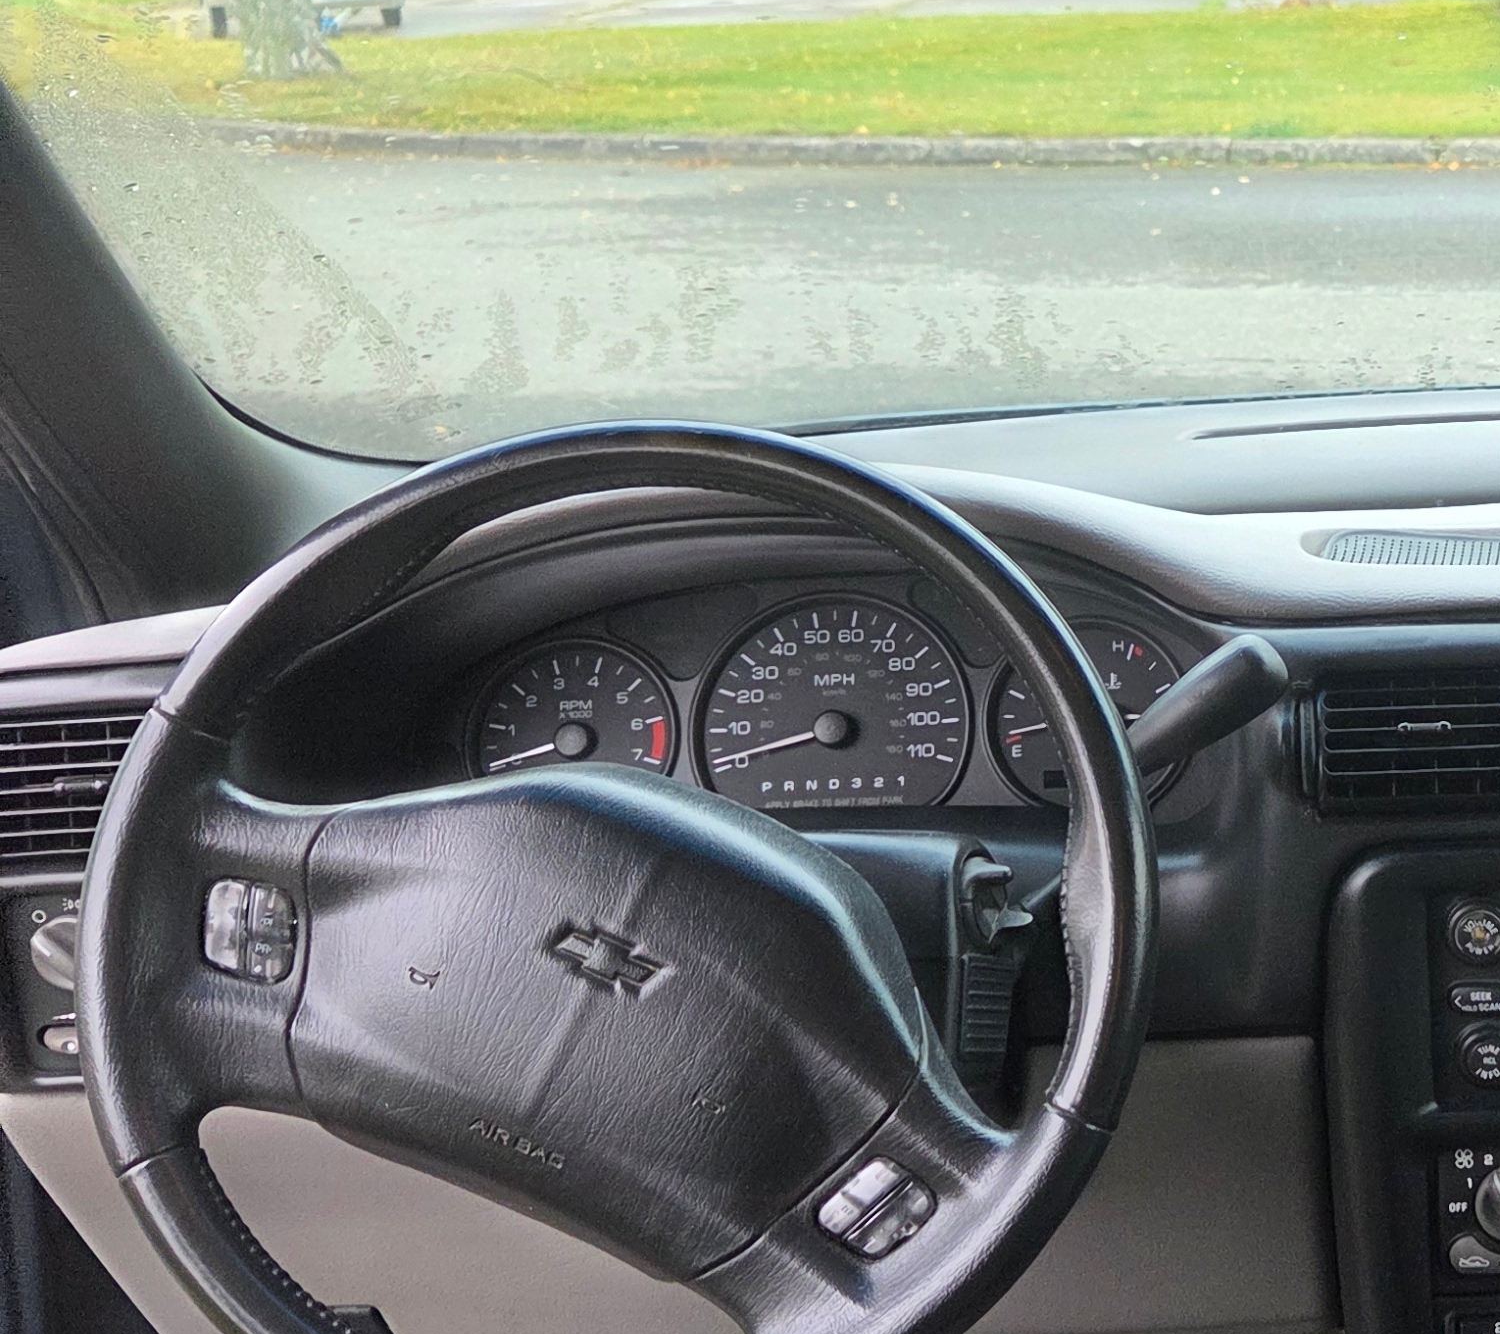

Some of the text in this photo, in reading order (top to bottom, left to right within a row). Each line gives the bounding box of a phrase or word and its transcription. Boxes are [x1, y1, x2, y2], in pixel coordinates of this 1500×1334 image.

[804, 630, 830, 644] 50
[838, 629, 864, 643] 60
[769, 642, 797, 656] 40
[870, 640, 895, 653] 70
[1112, 641, 1124, 652] H
[888, 657, 915, 671] 80
[752, 666, 779, 680] 30
[554, 678, 565, 690] 3
[587, 676, 599, 688] 4
[814, 673, 855, 687] MPH
[737, 689, 764, 703] 20
[906, 683, 932, 697] 90
[526, 695, 537, 708] 2
[616, 692, 628, 705] 5
[768, 693, 782, 701] 40
[886, 693, 903, 701] 140
[559, 699, 593, 711] RPM
[631, 718, 643, 730] 6
[906, 711, 940, 726] 100
[507, 724, 515, 736] 1
[728, 721, 750, 736] 10
[631, 748, 643, 760] 7
[906, 743, 934, 758] 110
[1012, 745, 1022, 757] E
[735, 754, 749, 768] 0
[761, 775, 905, 792] P R N D 3 2 1
[881, 795, 904, 804] PARK
[1463, 918, 1498, 935] VOLUME
[1470, 992, 1492, 1001] SEEK
[1477, 1044, 1500, 1056] TUNE
[1475, 1067, 1500, 1080] INFO
[1484, 1154, 1494, 1165] 2
[1467, 1177, 1473, 1189] 1
[1448, 1202, 1468, 1213] OFF
